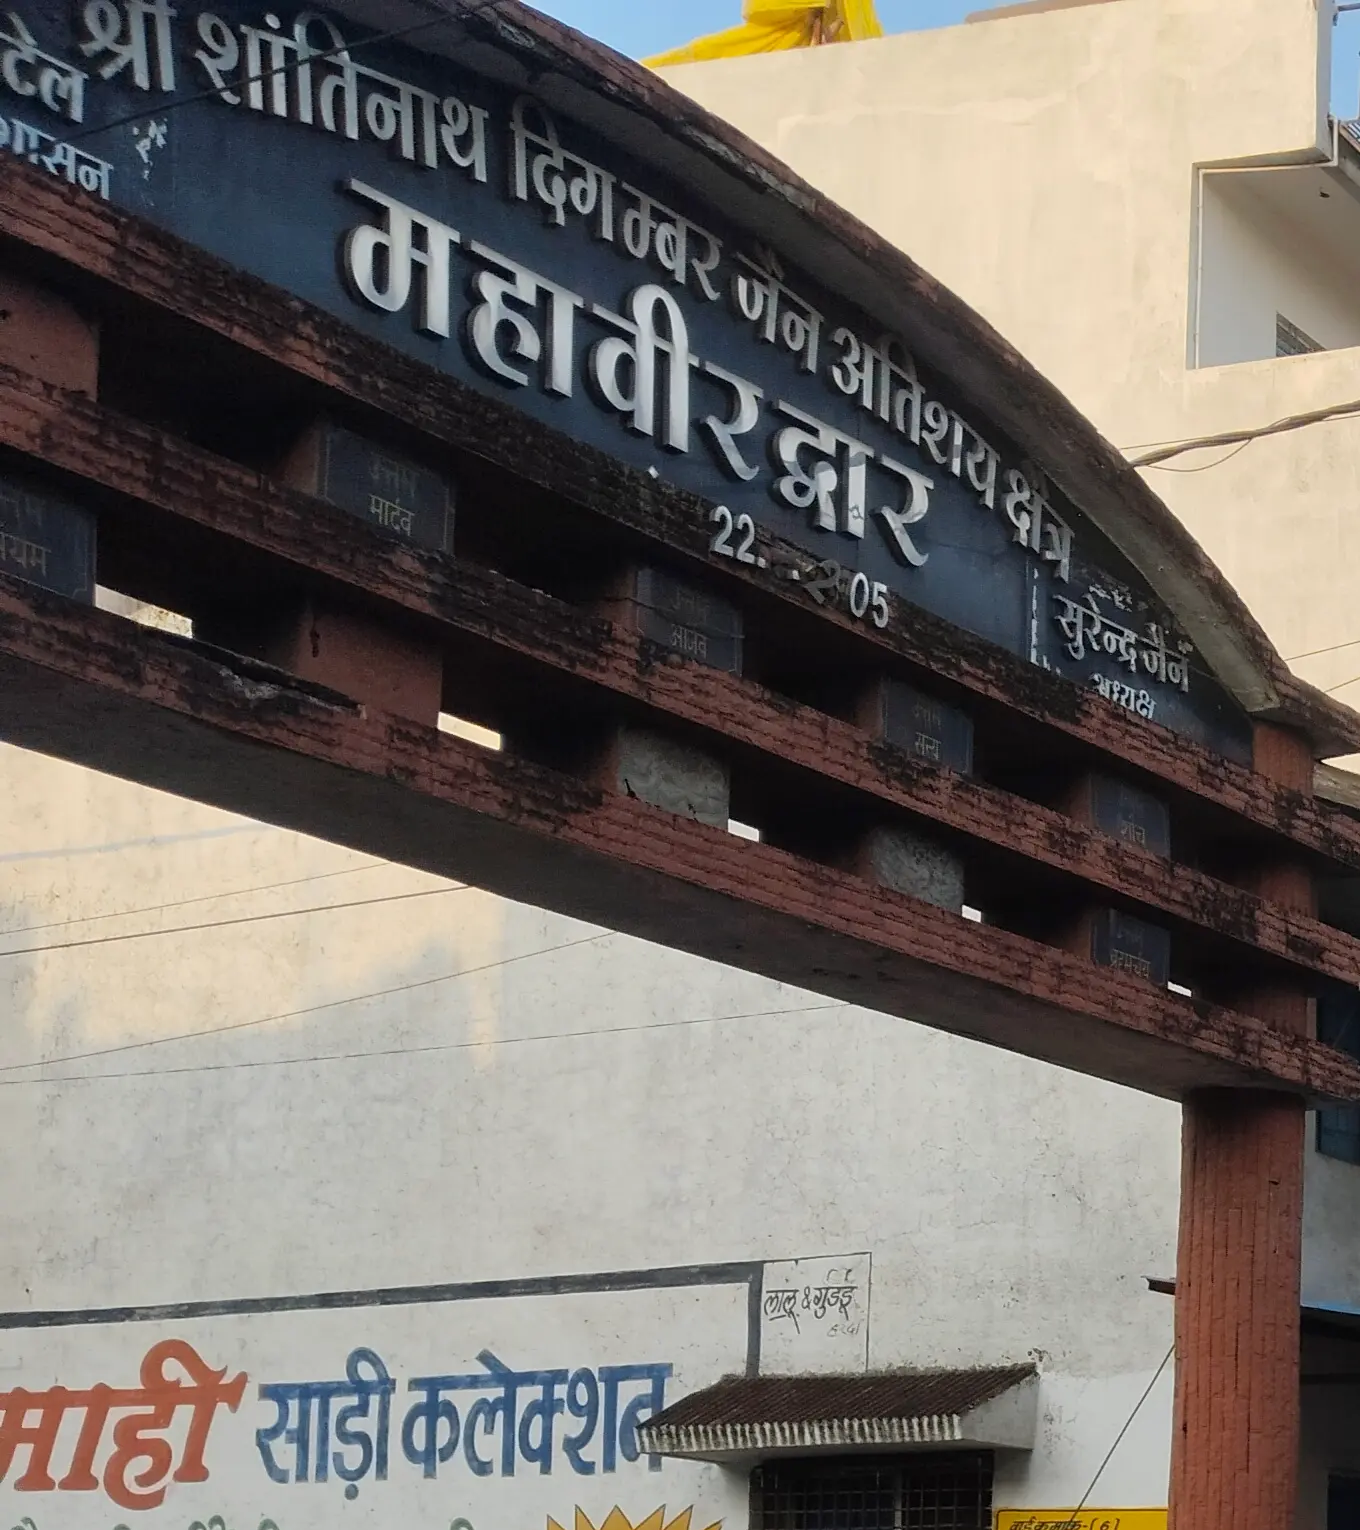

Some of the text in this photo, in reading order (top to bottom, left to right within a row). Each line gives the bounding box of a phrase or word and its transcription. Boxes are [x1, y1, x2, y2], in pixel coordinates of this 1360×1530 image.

[196, 12, 488, 183] शांतिनाथ
[731, 240, 823, 376] जैन
[829, 326, 1002, 511] अतिशय
[257, 1347, 396, 1500] साड़ी
